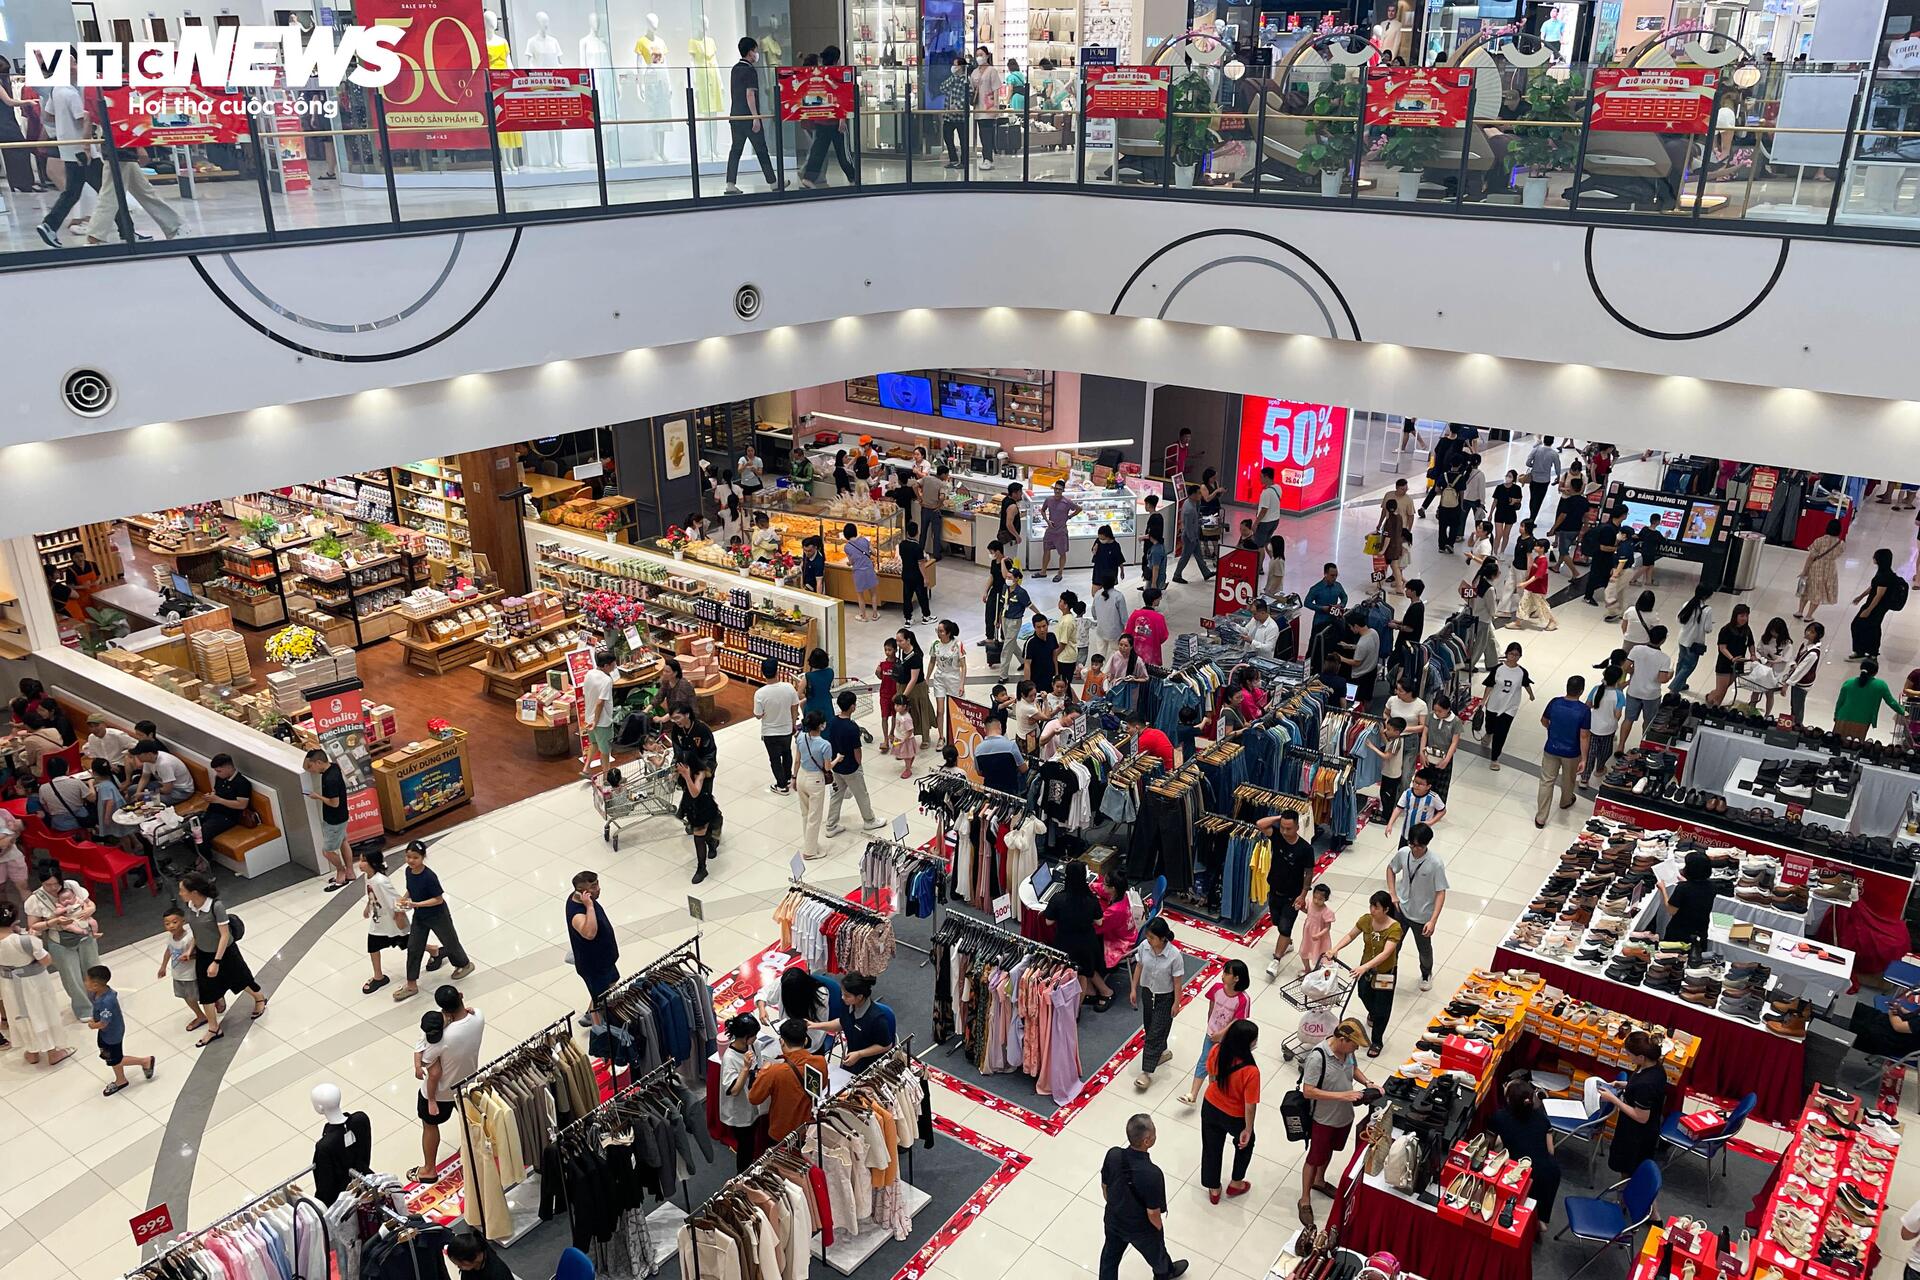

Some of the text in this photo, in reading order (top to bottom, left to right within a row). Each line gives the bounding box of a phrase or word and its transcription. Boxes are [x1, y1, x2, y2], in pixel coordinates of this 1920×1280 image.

[1640, 78, 1661, 86] HOẠT
[1663, 78, 1684, 86] ĐỘNG
[389, 114, 412, 124] TOÀN
[413, 114, 425, 124] BỘ
[426, 114, 443, 124] SẢN
[444, 113, 467, 124] PHẨM
[1655, 494, 1677, 504] THÔNG
[1677, 498, 1688, 506] TIN
[1659, 544, 1684, 555] MALL
[319, 711, 359, 728] Quality
[1777, 719, 1792, 728] 30
[318, 723, 364, 740] specialties
[1786, 862, 1809, 872] BEST
[1786, 870, 1805, 879] BUY
[136, 1215, 167, 1236] 399
